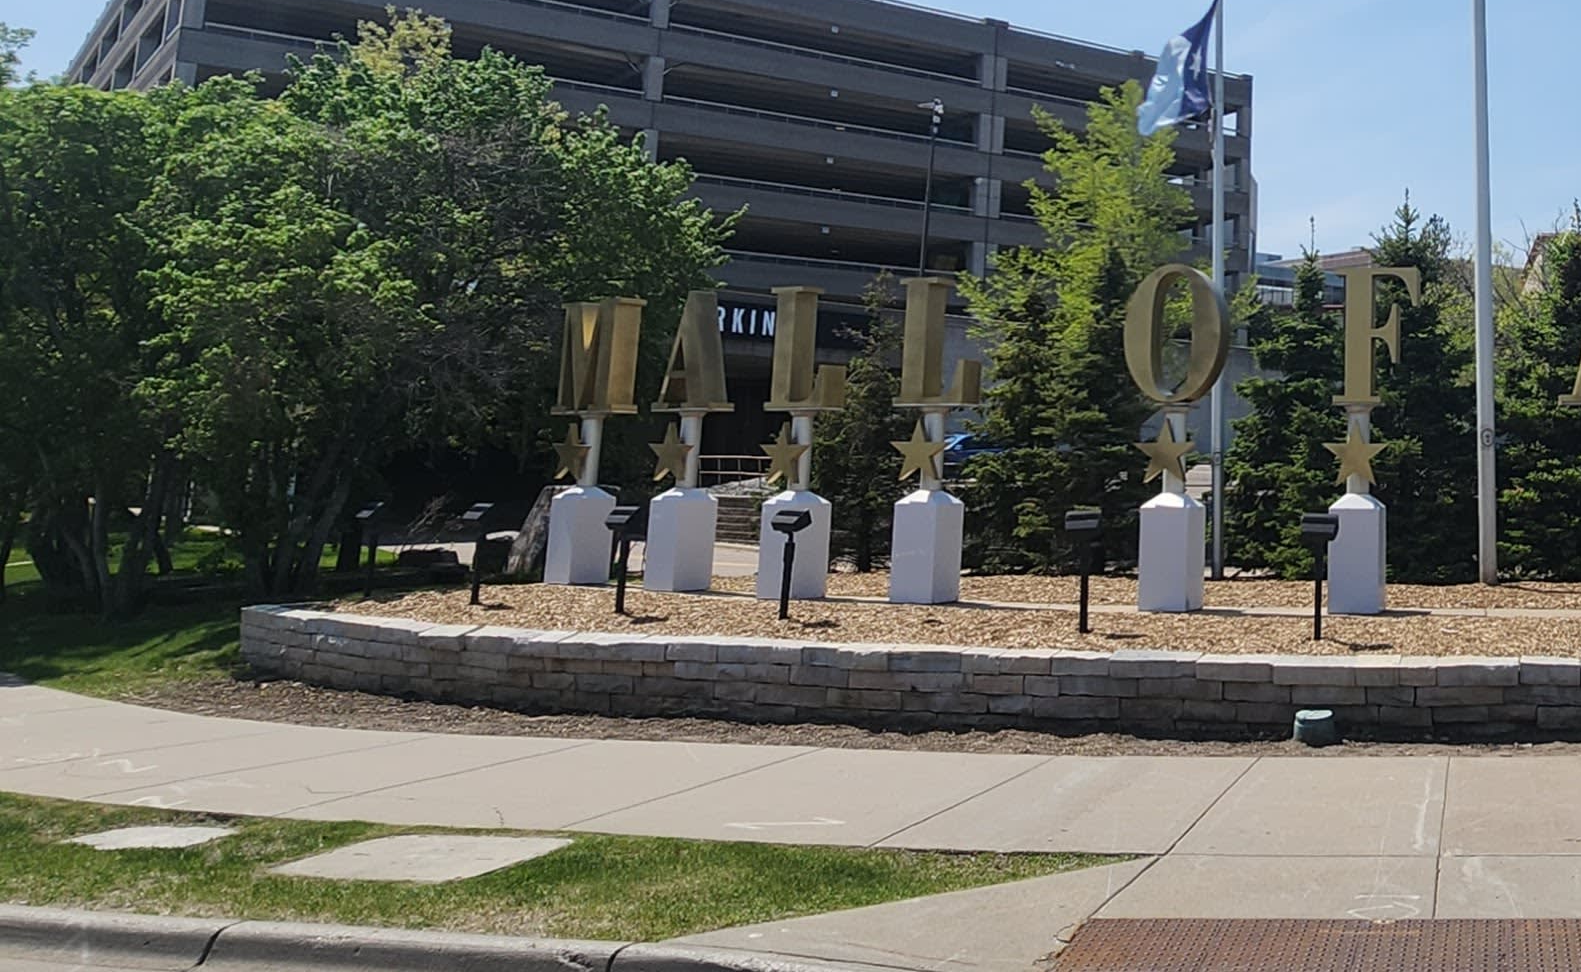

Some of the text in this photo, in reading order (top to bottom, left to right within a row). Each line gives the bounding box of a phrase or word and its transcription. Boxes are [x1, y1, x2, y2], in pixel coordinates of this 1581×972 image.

[550, 276, 982, 416] MALL
[1123, 263, 1422, 405] OF
[717, 305, 775, 337] RKIN
